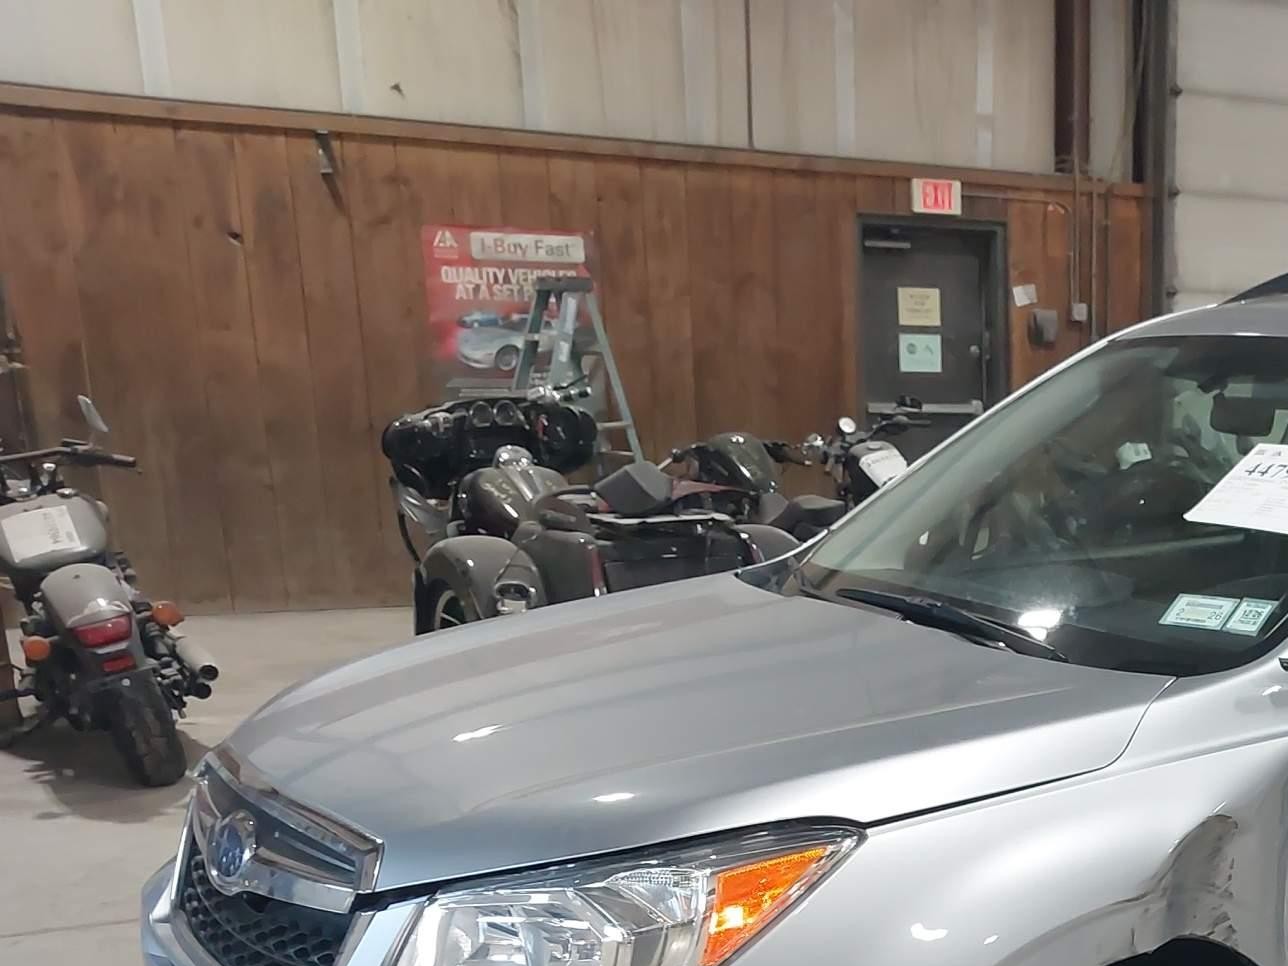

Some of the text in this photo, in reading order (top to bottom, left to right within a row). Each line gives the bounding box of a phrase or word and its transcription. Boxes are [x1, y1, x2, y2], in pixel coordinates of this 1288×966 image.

[441, 265, 506, 285] QUALITY
[455, 283, 476, 301] AT
[479, 284, 491, 301] A
[494, 284, 522, 303] SET
